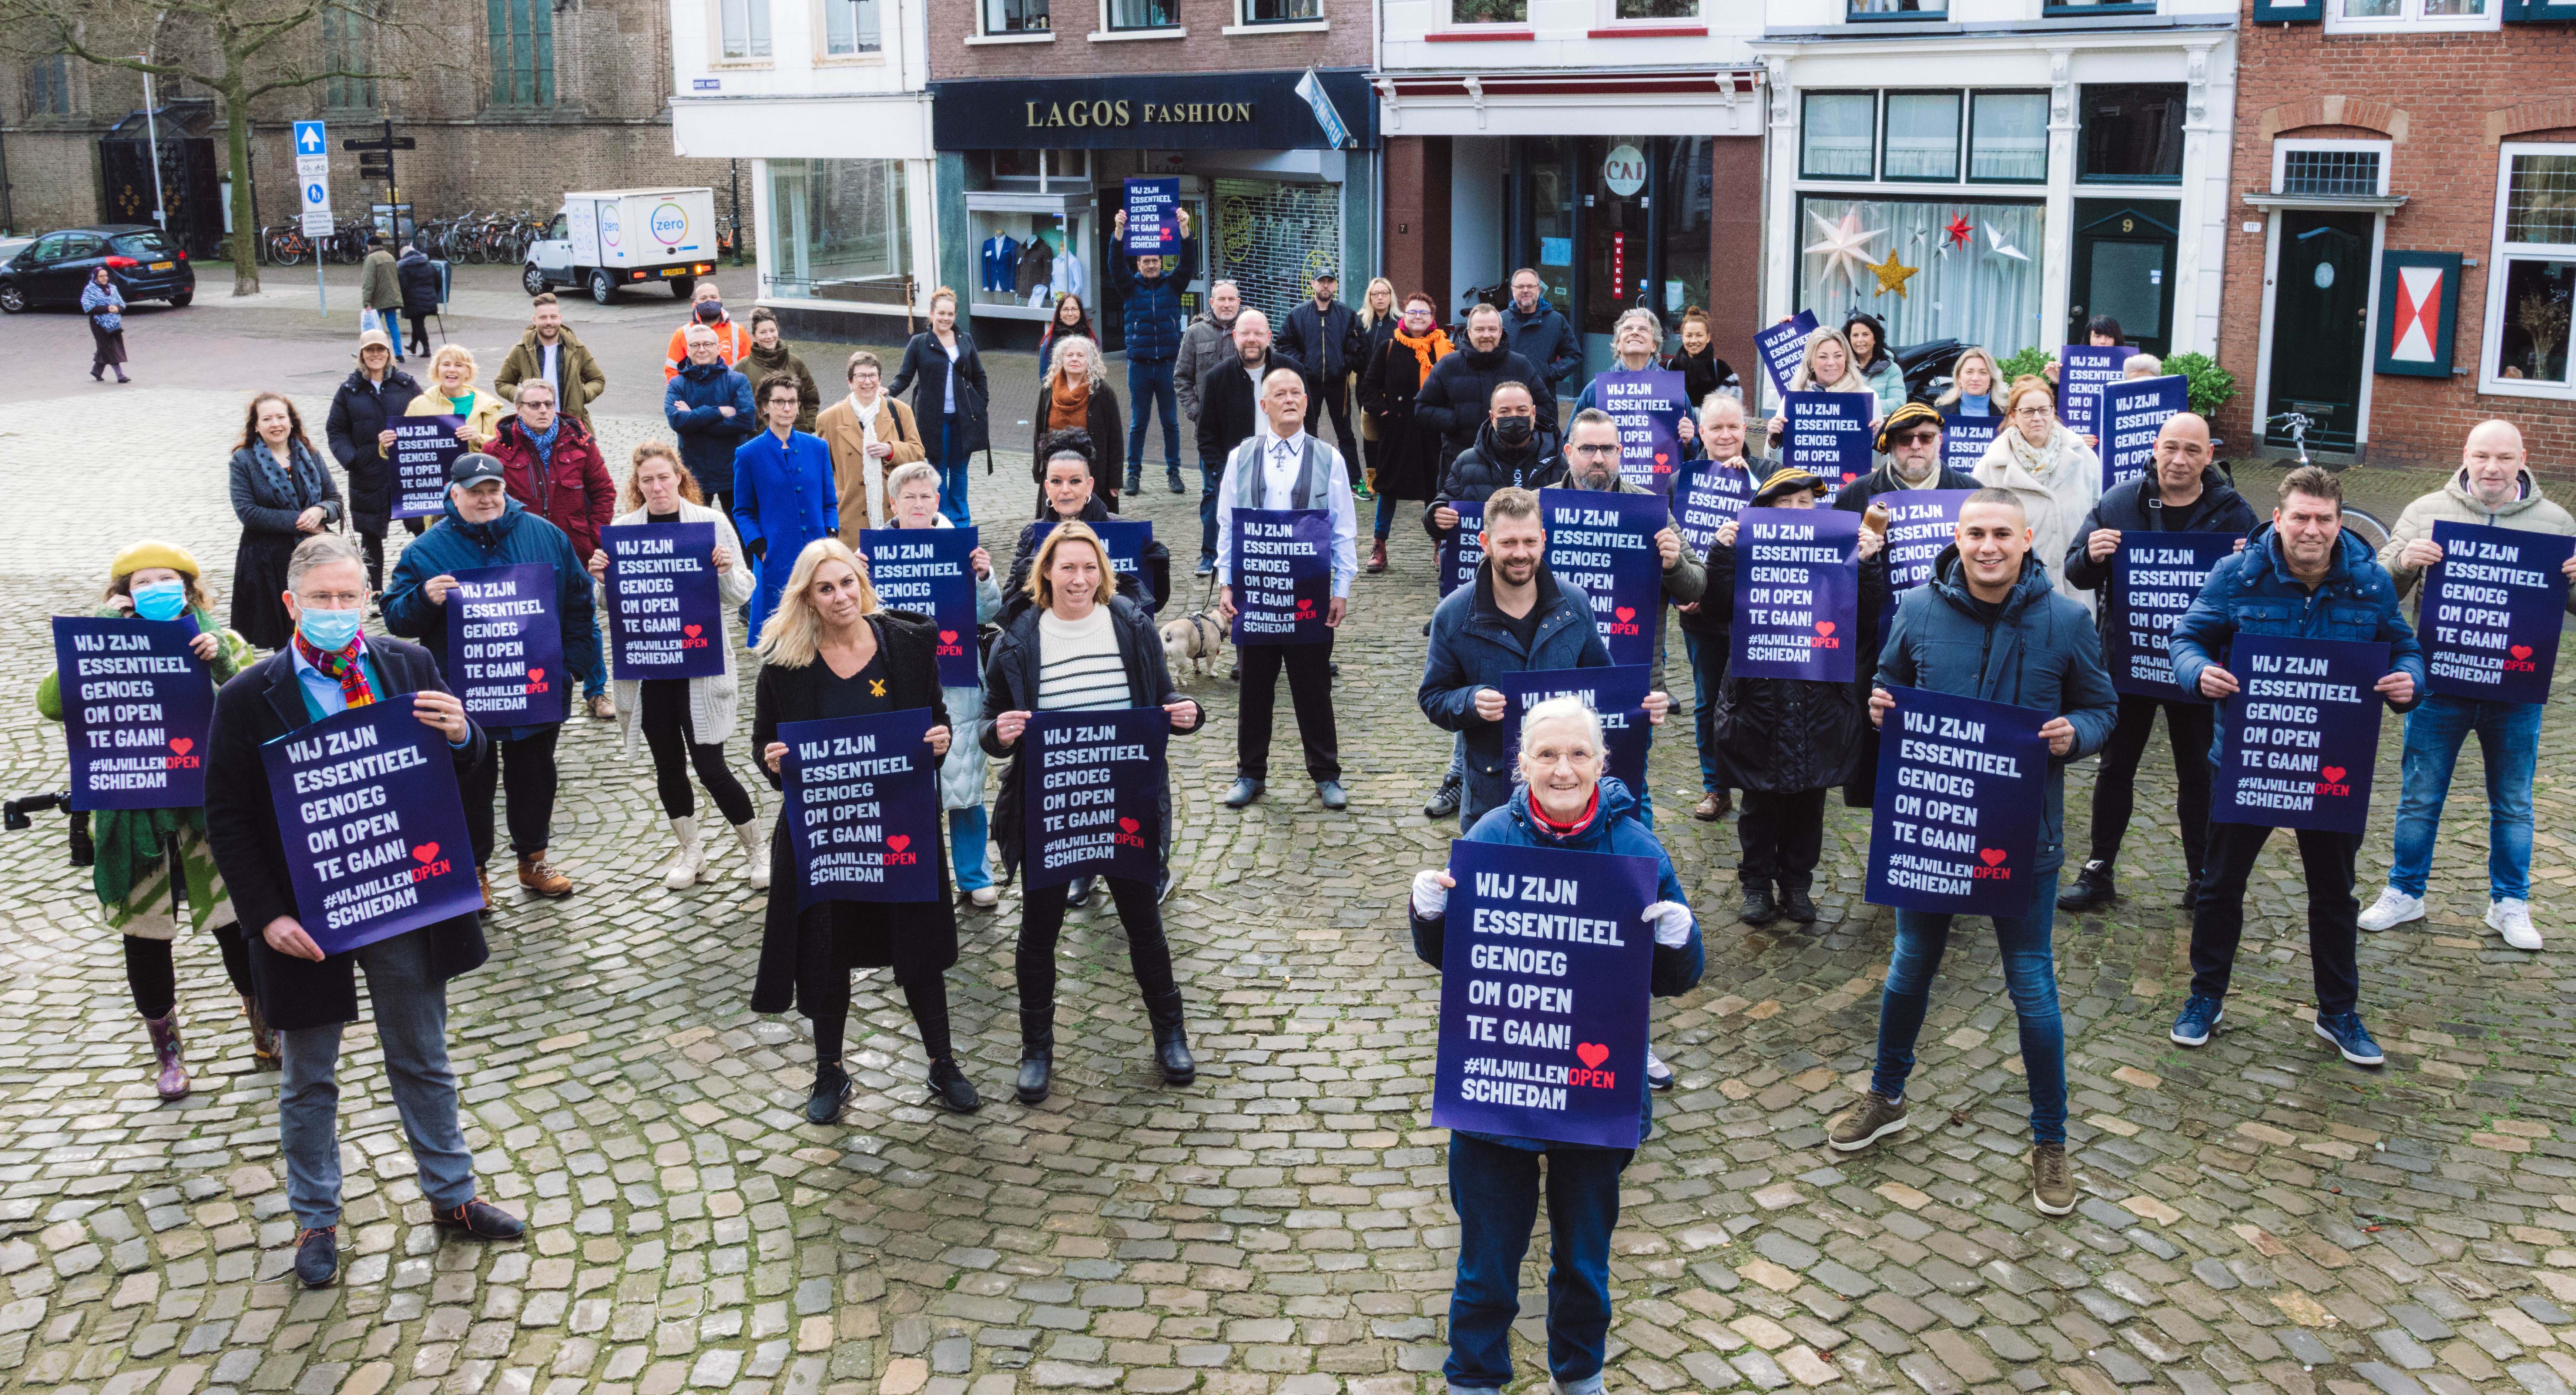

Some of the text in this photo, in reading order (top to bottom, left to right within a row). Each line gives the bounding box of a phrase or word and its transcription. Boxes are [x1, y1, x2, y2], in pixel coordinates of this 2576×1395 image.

[1026, 100, 1251, 127] LAGOS FASHION
[1312, 90, 1342, 143] OMERIJ
[1606, 161, 1643, 180] CAI
[1131, 195, 1171, 203] ESSENTIEEL
[604, 222, 619, 232] zero
[657, 220, 683, 230] zero
[2123, 219, 2133, 232] 9
[1607, 383, 1651, 395] WIJ ZIJN
[1607, 399, 1672, 411] ESSENTIEEL
[1795, 404, 1840, 415] WIJ ZIJN
[396, 426, 437, 437] WIJ ZIJN
[1795, 419, 1861, 431] ESSENTIEEL
[398, 438, 457, 450] ESSENTIEEL
[1624, 431, 1652, 442] OPEN
[1795, 435, 1837, 446] GENOEG
[399, 452, 437, 463] GENOEG
[1623, 447, 1652, 458] GAAN!
[1794, 450, 1839, 462] OM OPEN
[400, 465, 441, 476] OM OPEN
[1810, 466, 1839, 477] GAAN!
[401, 477, 442, 488] TE GAAN!
[1244, 522, 1294, 537] WIJ ZIJN
[1753, 524, 1814, 540] WIJ ZIJN
[1244, 540, 1317, 555] ESSENTIEEL
[1752, 546, 1842, 563] ESSENTIEEL
[2449, 540, 2519, 562] WIJ ZIJN
[1243, 558, 1289, 573] GENOEG
[2445, 561, 2548, 588] ESSENTIEEL
[1244, 576, 1293, 590] OM OPEN
[1751, 567, 1809, 584] GENOEG
[460, 581, 516, 598] WIJ ZIJN
[1246, 591, 1294, 606] TE GAAN!
[1750, 588, 1812, 605] OM OPEN
[2442, 583, 2508, 604] GENOEG
[463, 600, 544, 618] ESSENTIEEL
[1244, 611, 1316, 622] #WIJWILLENOPEN
[1749, 609, 1812, 626] TE GAAN!
[2439, 605, 2510, 627] OM OPEN
[464, 620, 520, 638] GENOEG
[1244, 621, 1294, 633] SCHIEDAM
[74, 635, 150, 651] WIJ ZIJN
[1749, 634, 1839, 648] #WIJWILLENOPEN
[2436, 627, 2508, 649] TE GAAN!
[464, 641, 523, 658] OM OPEN
[1748, 647, 1810, 662] SCHIEDAM
[78, 657, 191, 676] ESSENTIEEL
[464, 661, 525, 678] TE GAAN!
[2253, 655, 2328, 676] WIJ ZIJN
[2433, 651, 2535, 672] #WIJWILLENOPEN
[2431, 663, 2501, 684] SCHIEDAM
[81, 681, 154, 700] GENOEG
[466, 683, 548, 697] #WIJWILLENOPEN
[2249, 680, 2361, 702] ESSENTIEEL
[84, 704, 162, 723] OM OPEN
[466, 697, 526, 711] SCHIEDAM
[2247, 703, 2317, 723] GENOEG
[1904, 711, 1985, 743] WIJ ZIJN
[87, 728, 165, 747] TE GAAN!
[286, 725, 378, 763] WIJ ZIJN
[2244, 727, 2321, 748] OM OPEN
[799, 735, 875, 760] WIJ ZIJN
[90, 755, 199, 771] #WIJWILLENOPEN
[1901, 739, 2021, 778] ESSENTIEEL
[2241, 750, 2318, 771] TE GAAN!
[294, 746, 427, 794] ESSENTIEEL
[802, 756, 913, 782] ESSENTIEEL
[90, 772, 166, 790] SCHIEDAM
[1898, 767, 1974, 798] GENOEG
[2238, 778, 2349, 796] #WIJWILLENOPEN
[803, 783, 873, 803] GENOEG
[2235, 791, 2313, 810] SCHIEDAM
[301, 786, 386, 823] GENOEG
[805, 802, 880, 826] OM OPEN
[1895, 795, 1978, 826] OM OPEN
[308, 811, 399, 853] OM OPEN
[808, 825, 881, 848] TE GAAN!
[1893, 821, 1976, 853] TE GAAN!
[313, 839, 407, 882] TE GAAN!
[811, 849, 916, 868] #WIJWILLENOPEN
[1890, 854, 2010, 879] #WIJWILLENOPEN
[323, 859, 450, 909] #WIJWILLENOPEN
[811, 867, 883, 885] SCHIEDAM
[1888, 869, 1971, 895] SCHIEDAM
[1476, 872, 1577, 905] WIJ ZIJN
[327, 887, 417, 929] SCHIEDAM
[1473, 909, 1624, 946] ESSENTIEEL
[1471, 945, 1567, 976] GENOEG
[1469, 980, 1572, 1013] OM OPEN
[1467, 1015, 1571, 1050] TE GAAN!
[1464, 1058, 1614, 1089] #WIJWILLENOPEN
[1462, 1079, 1566, 1110] SCHIEDAM
